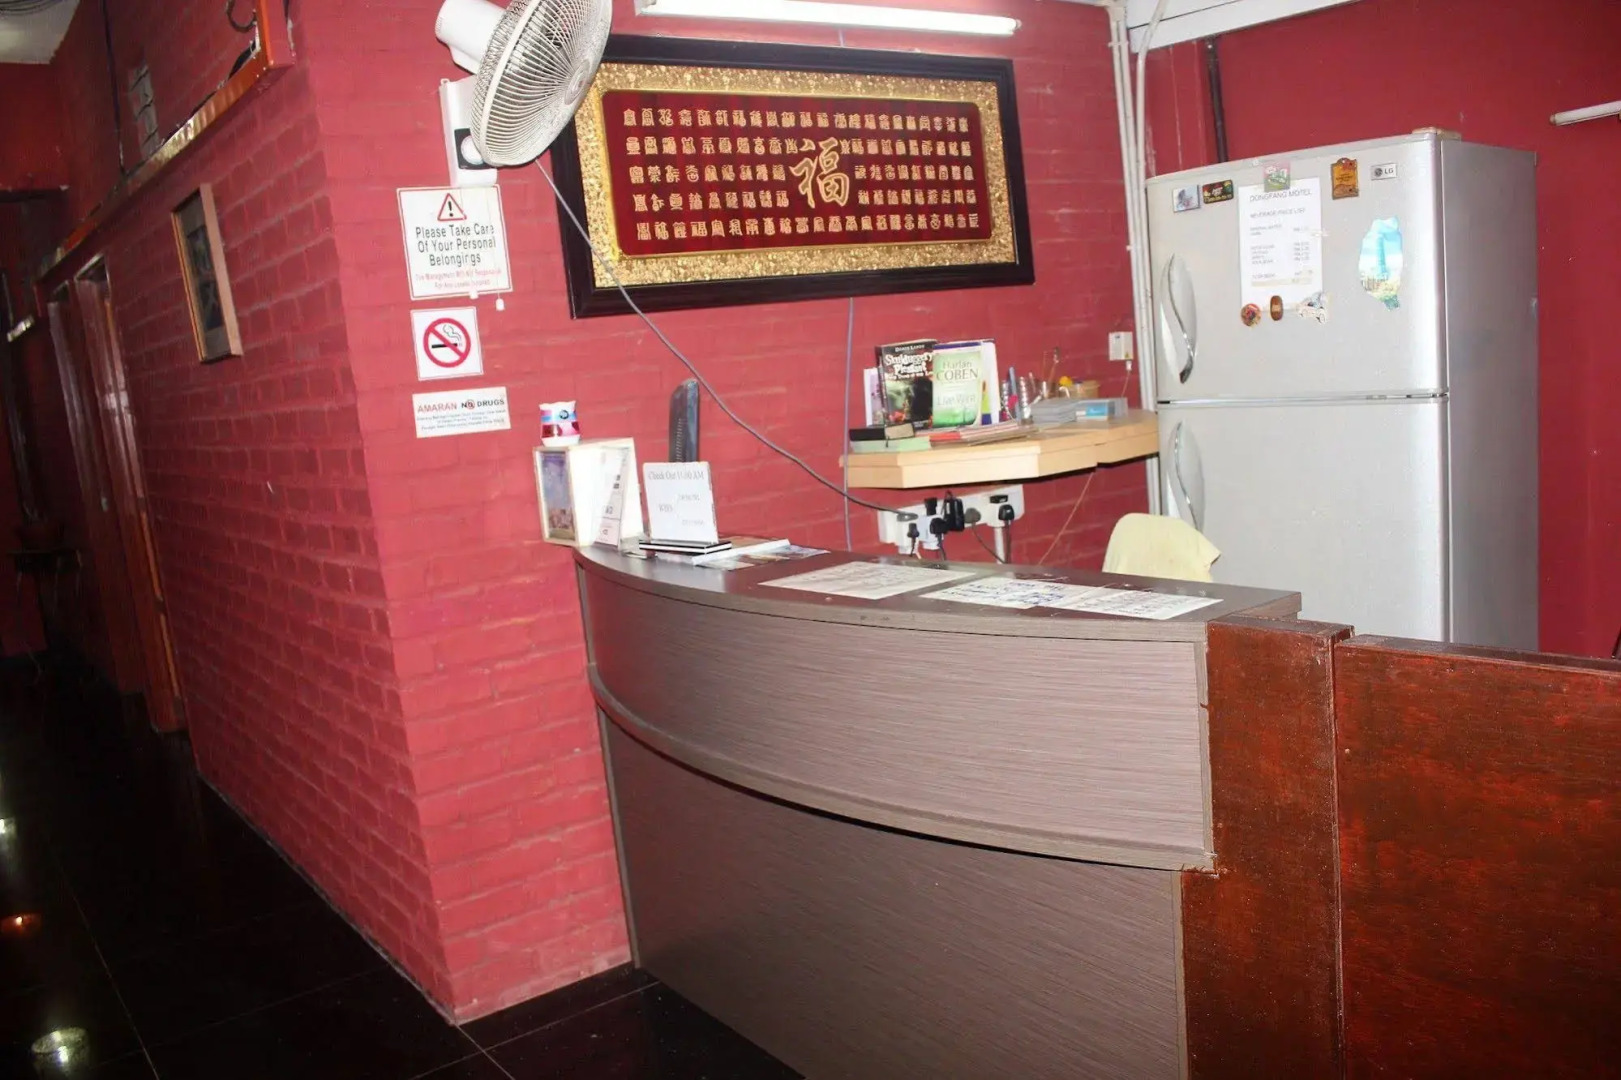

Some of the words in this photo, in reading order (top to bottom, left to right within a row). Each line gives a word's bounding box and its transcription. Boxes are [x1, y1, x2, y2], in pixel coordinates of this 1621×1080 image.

[789, 137, 850, 209] 福
[1384, 167, 1394, 175] LG
[1289, 189, 1312, 197] MOTEL
[415, 226, 447, 239] Please
[449, 224, 471, 237] Take
[474, 223, 495, 235] Care
[417, 240, 429, 253] Of
[432, 239, 454, 252] Your
[456, 236, 496, 250] Personal
[429, 252, 481, 267] Belongings
[942, 360, 972, 369] Harlan
[936, 368, 979, 381] COBEN
[417, 402, 458, 413] AMARAN
[477, 398, 505, 408] DRUGS
